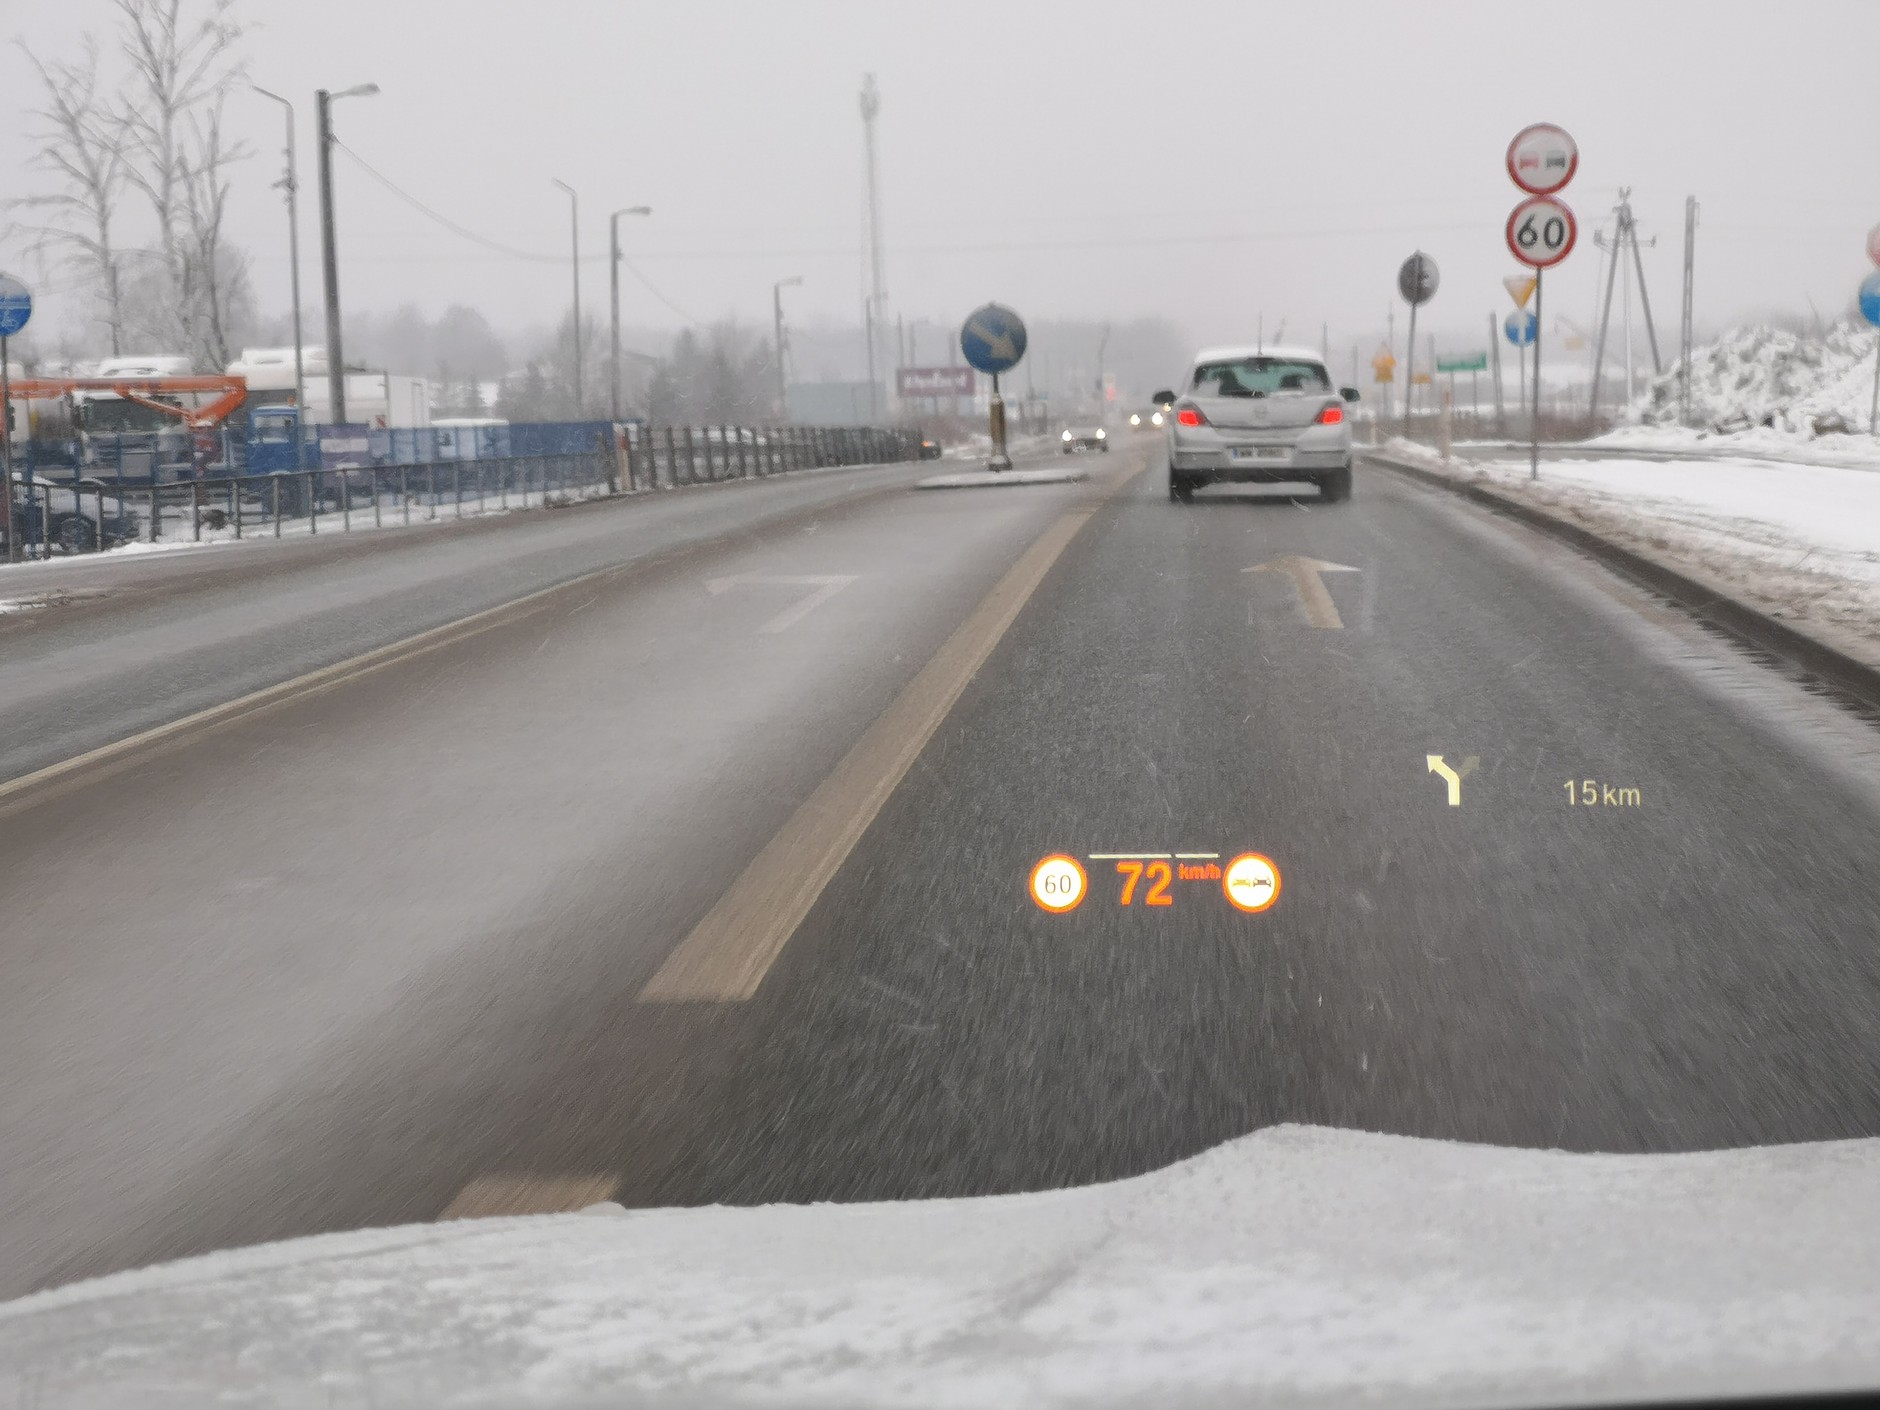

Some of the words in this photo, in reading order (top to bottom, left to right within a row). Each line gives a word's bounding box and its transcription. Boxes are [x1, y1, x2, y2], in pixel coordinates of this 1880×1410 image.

[1517, 213, 1565, 250] 60
[1044, 873, 1072, 895] 60
[1116, 860, 1173, 906] 72
[1177, 862, 1221, 880] km/h
